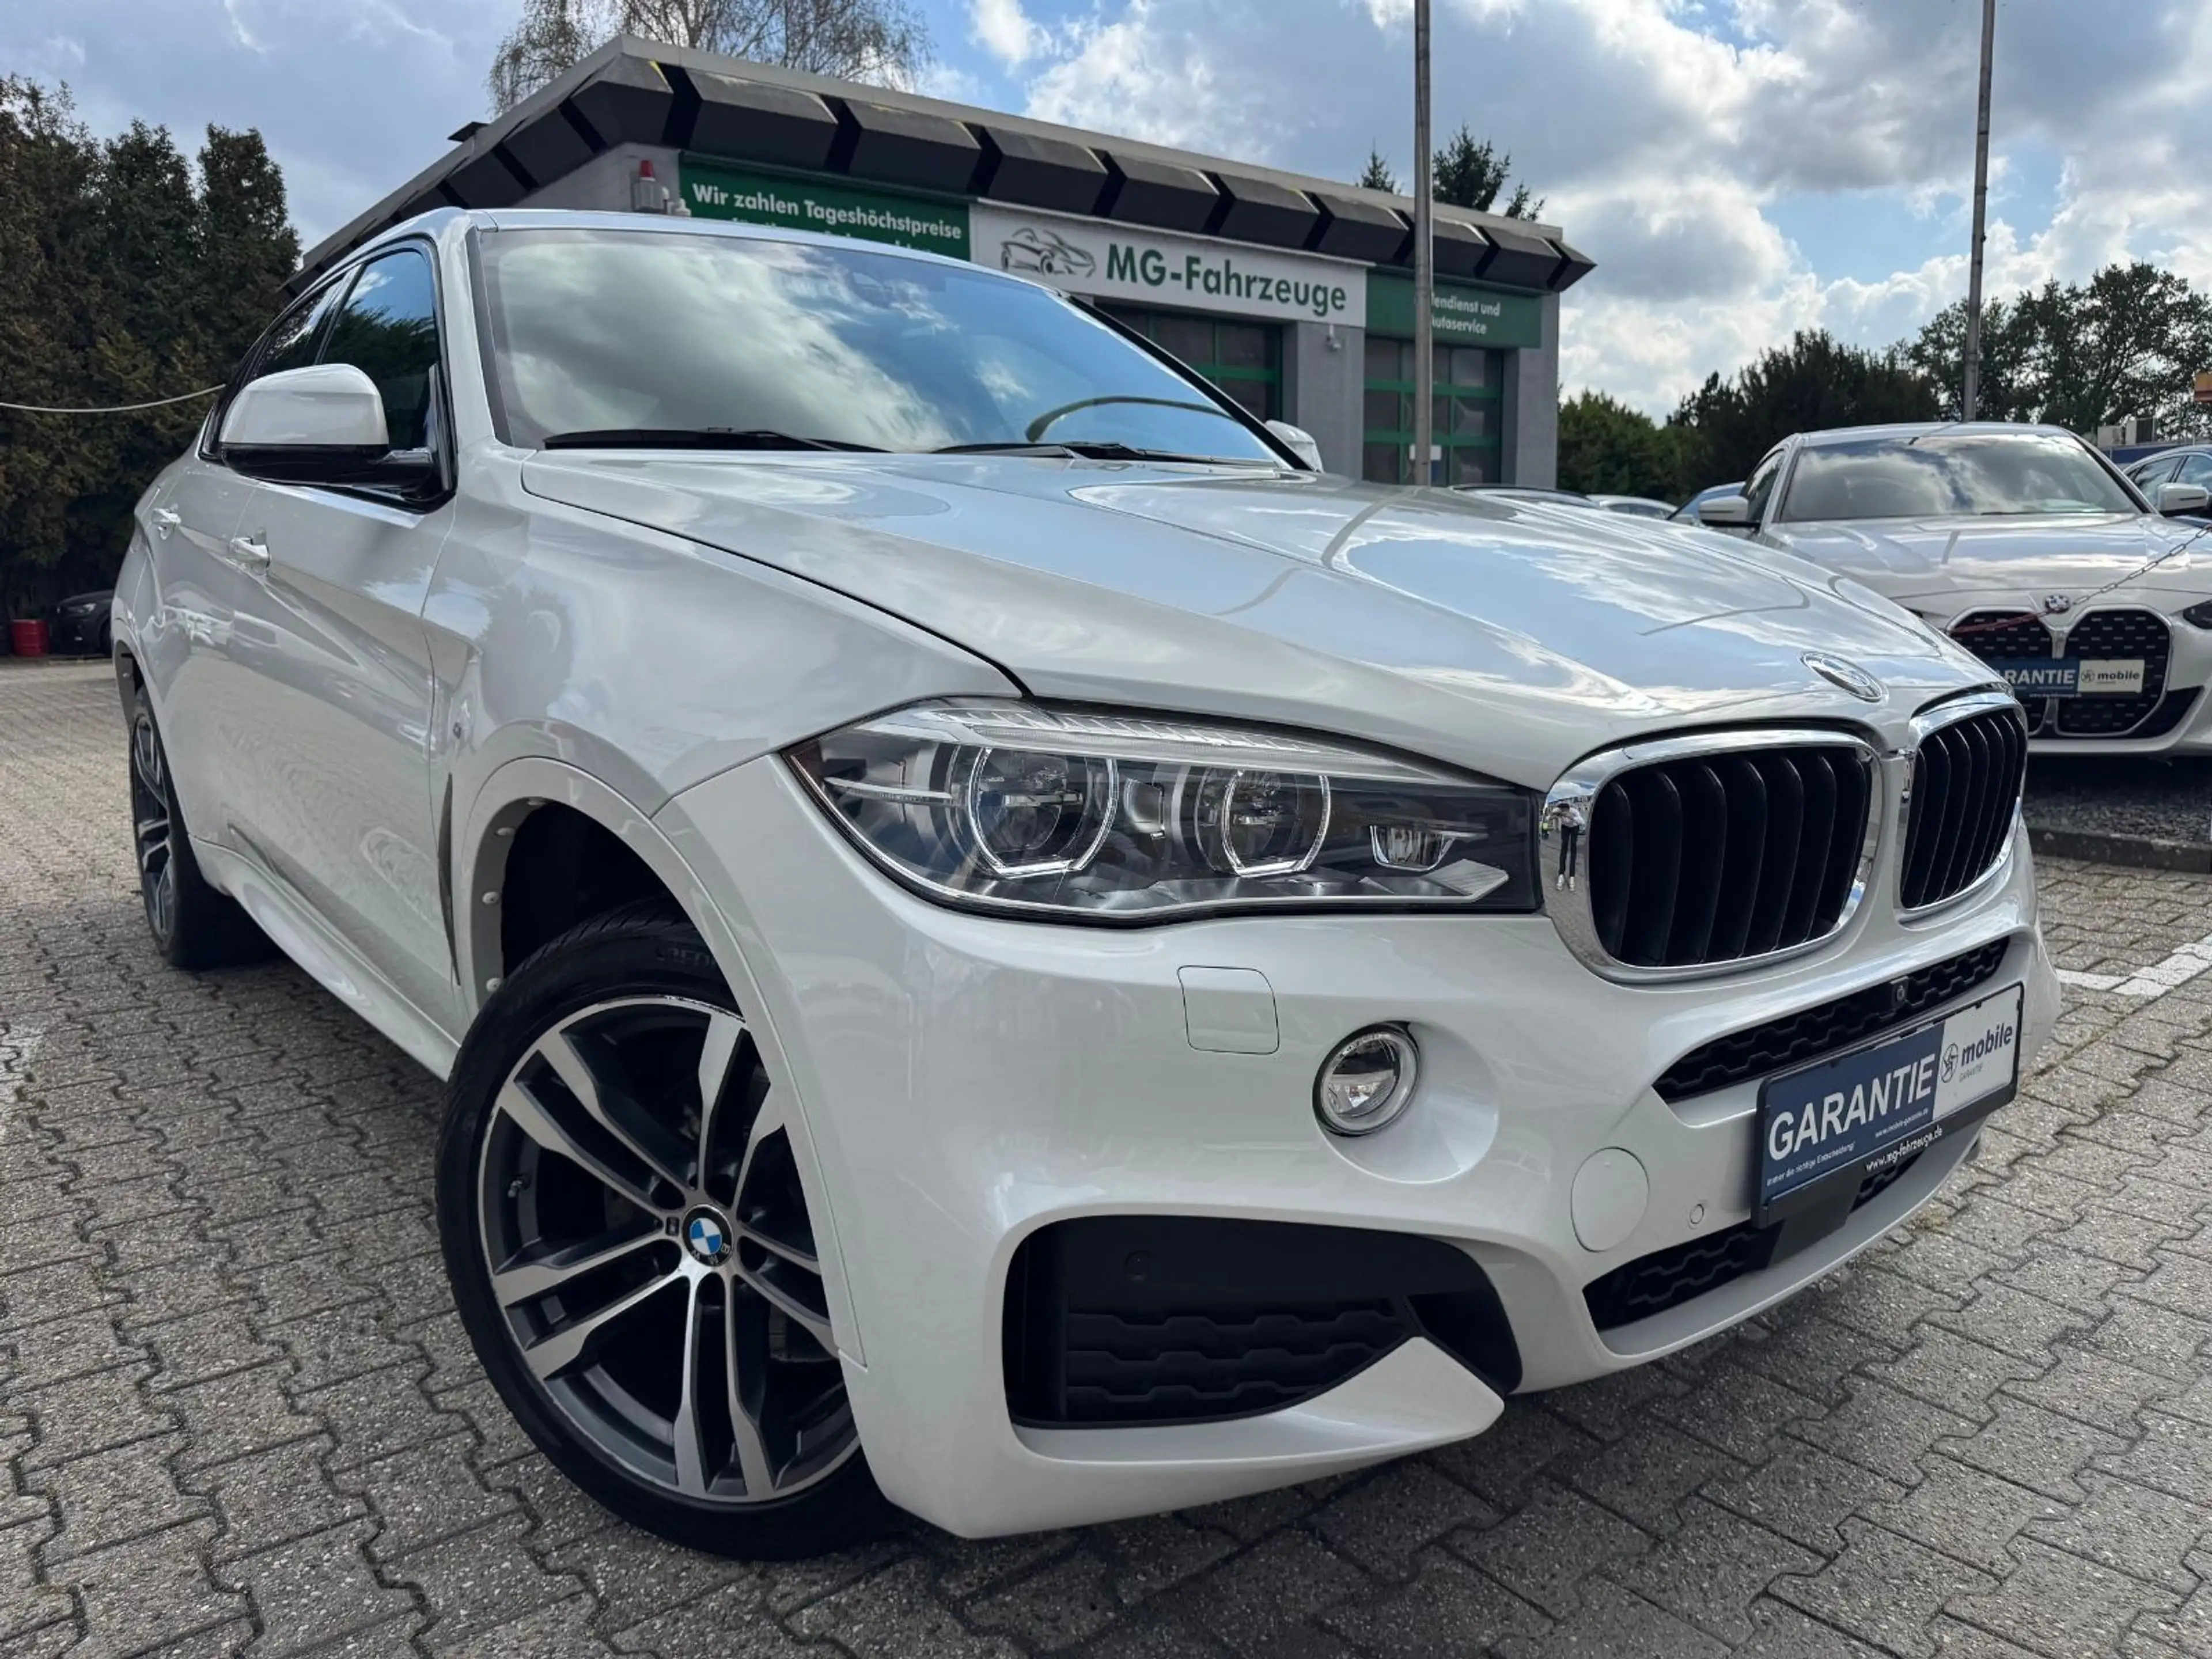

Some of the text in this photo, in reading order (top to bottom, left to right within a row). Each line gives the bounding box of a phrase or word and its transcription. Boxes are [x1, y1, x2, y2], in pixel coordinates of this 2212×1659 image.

[692, 183, 962, 239] Wir zahlen Tageshöchstpreise
[1106, 243, 1347, 317] MG-Fahrzeuge
[1480, 301, 1501, 317] und
[1995, 669, 2076, 684] RANTIE
[2097, 671, 2140, 680] mobile
[1961, 1022, 2013, 1067] mobile
[1768, 1052, 1936, 1161] GARANTIE
